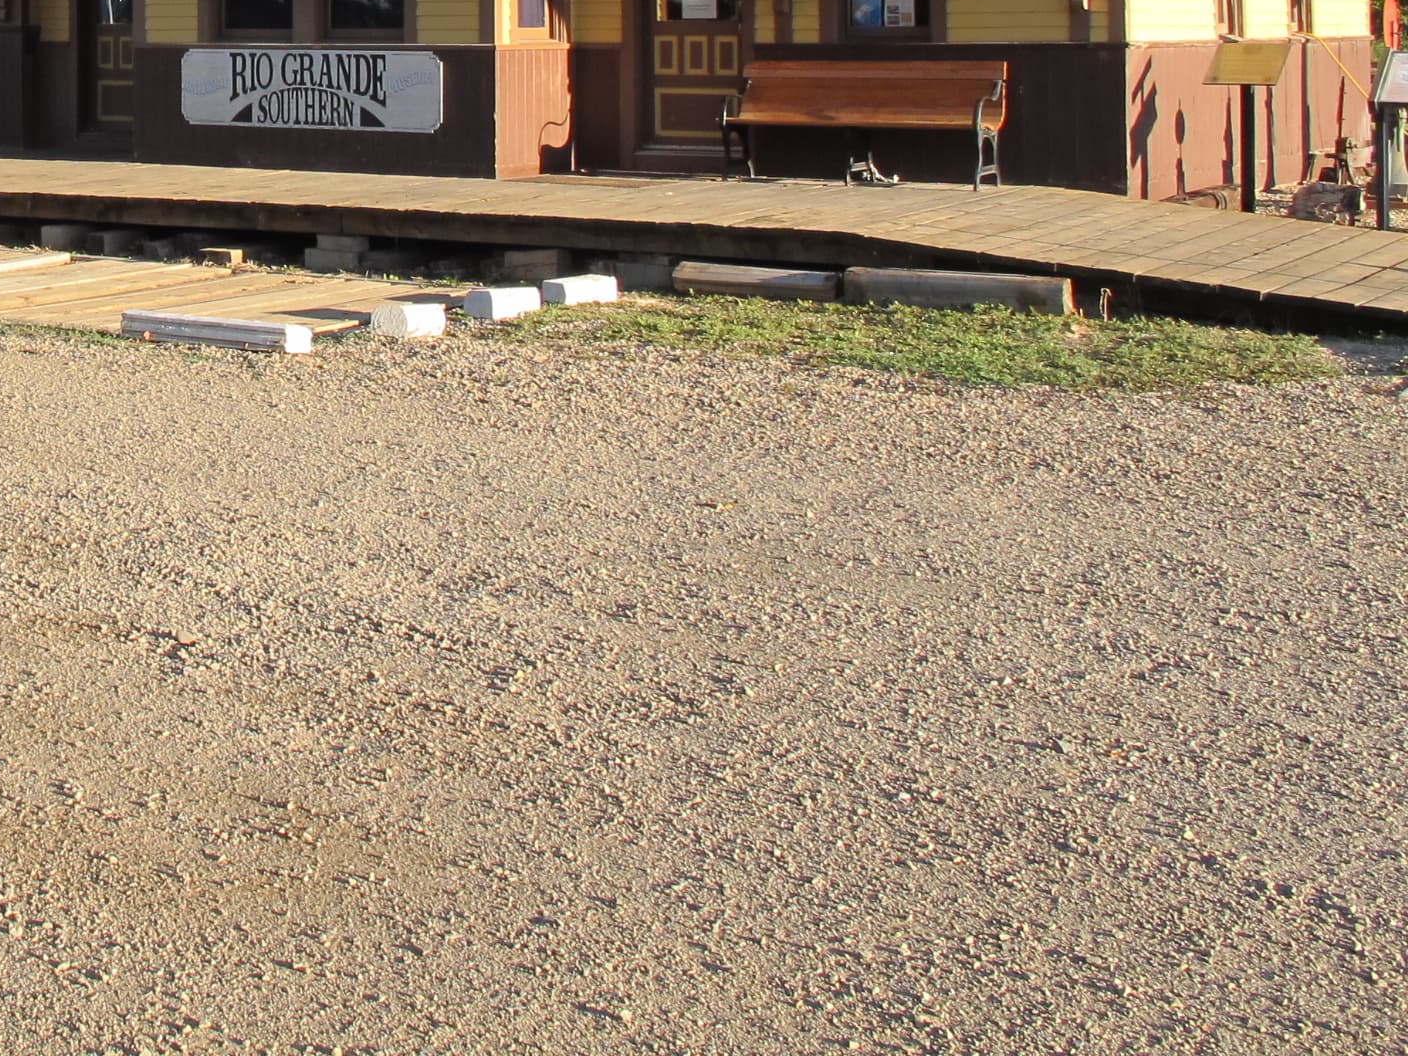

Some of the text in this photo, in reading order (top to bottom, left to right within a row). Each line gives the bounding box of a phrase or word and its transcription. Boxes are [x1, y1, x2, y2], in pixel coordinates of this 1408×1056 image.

[229, 52, 387, 106] RIO GRANDE
[257, 87, 356, 127] SOUTHERN
